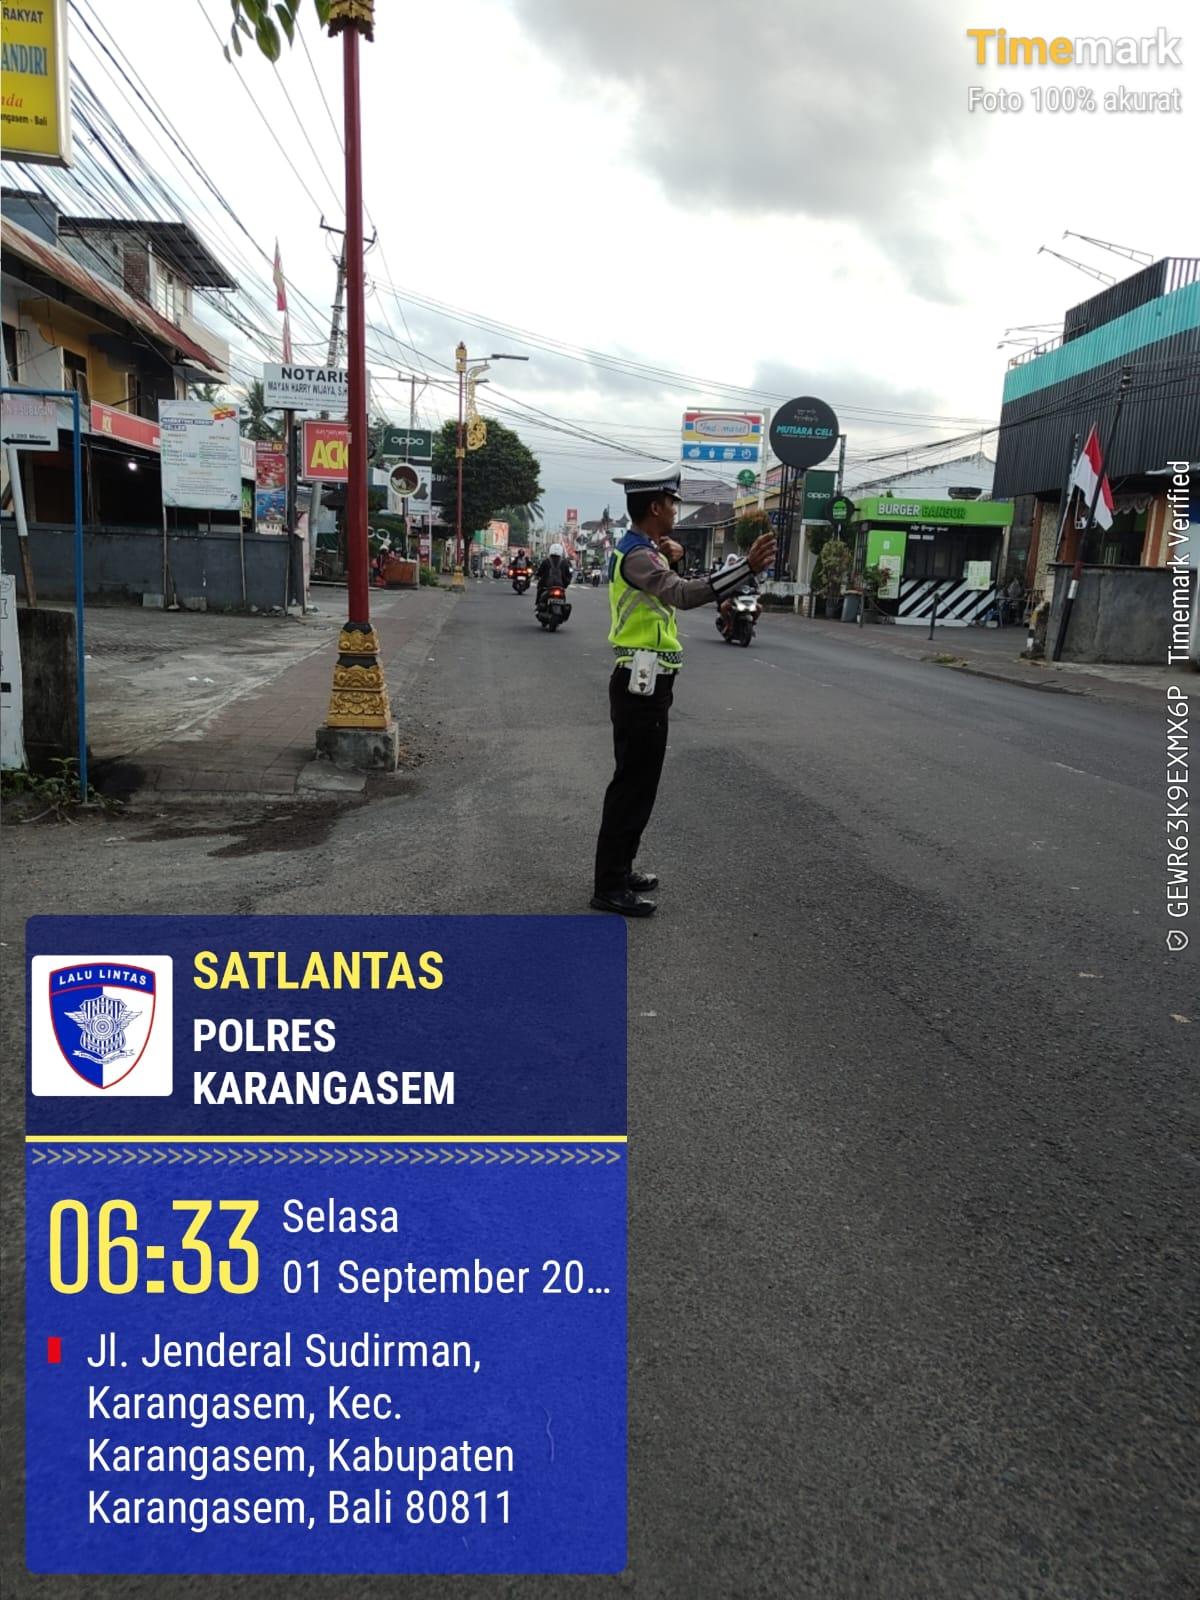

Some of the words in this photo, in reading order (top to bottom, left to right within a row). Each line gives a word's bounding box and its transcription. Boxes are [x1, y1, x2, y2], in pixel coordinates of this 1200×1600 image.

[3, 7, 44, 24] RAKYAT
[34, 115, 48, 126] Bali
[776, 425, 813, 436] MUTIARA
[814, 427, 834, 437] CELL
[310, 440, 349, 470] ACK
[878, 504, 921, 517] BURGER
